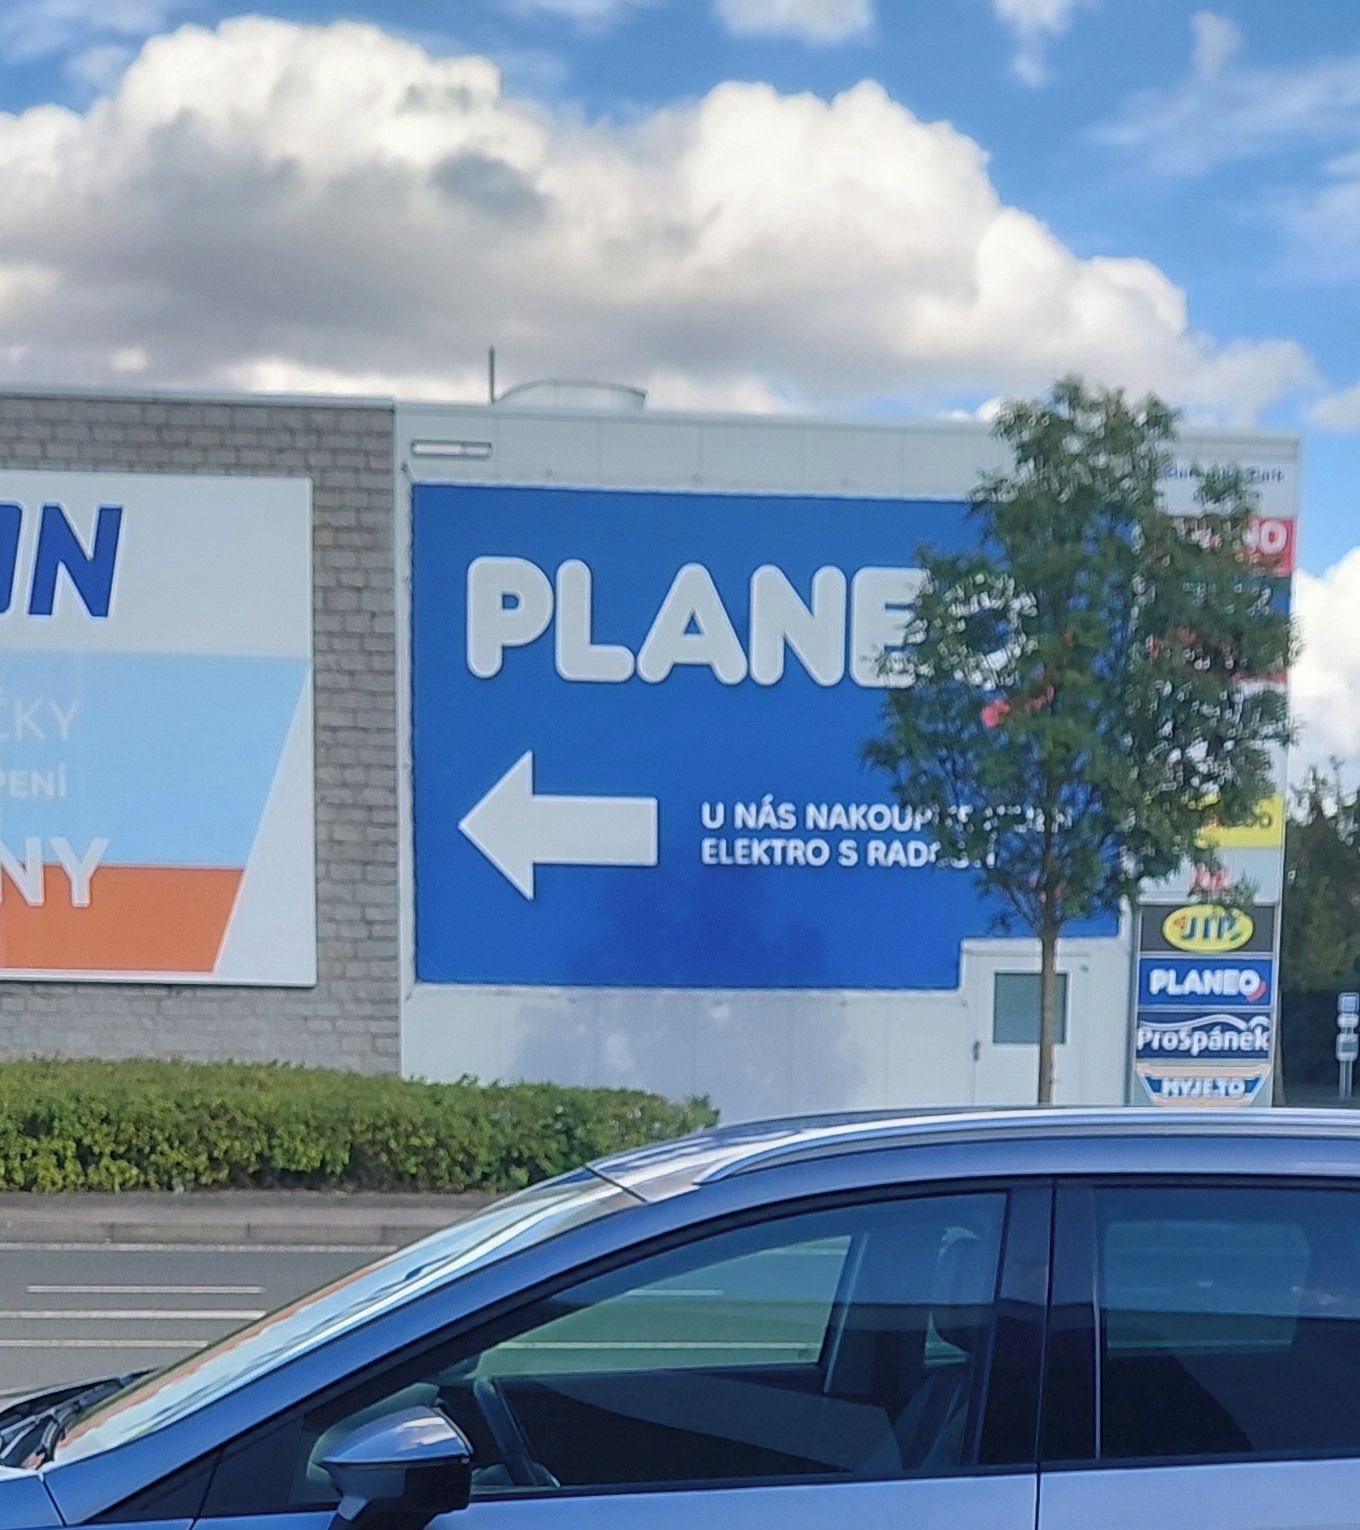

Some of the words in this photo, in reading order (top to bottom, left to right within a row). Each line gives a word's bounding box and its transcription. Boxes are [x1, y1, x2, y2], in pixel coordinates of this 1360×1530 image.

[701, 801, 725, 830] U
[734, 793, 797, 831] NÁS
[701, 837, 831, 866] ELEKTRO
[838, 838, 859, 867] S
[1149, 969, 1261, 996] PLANEO
